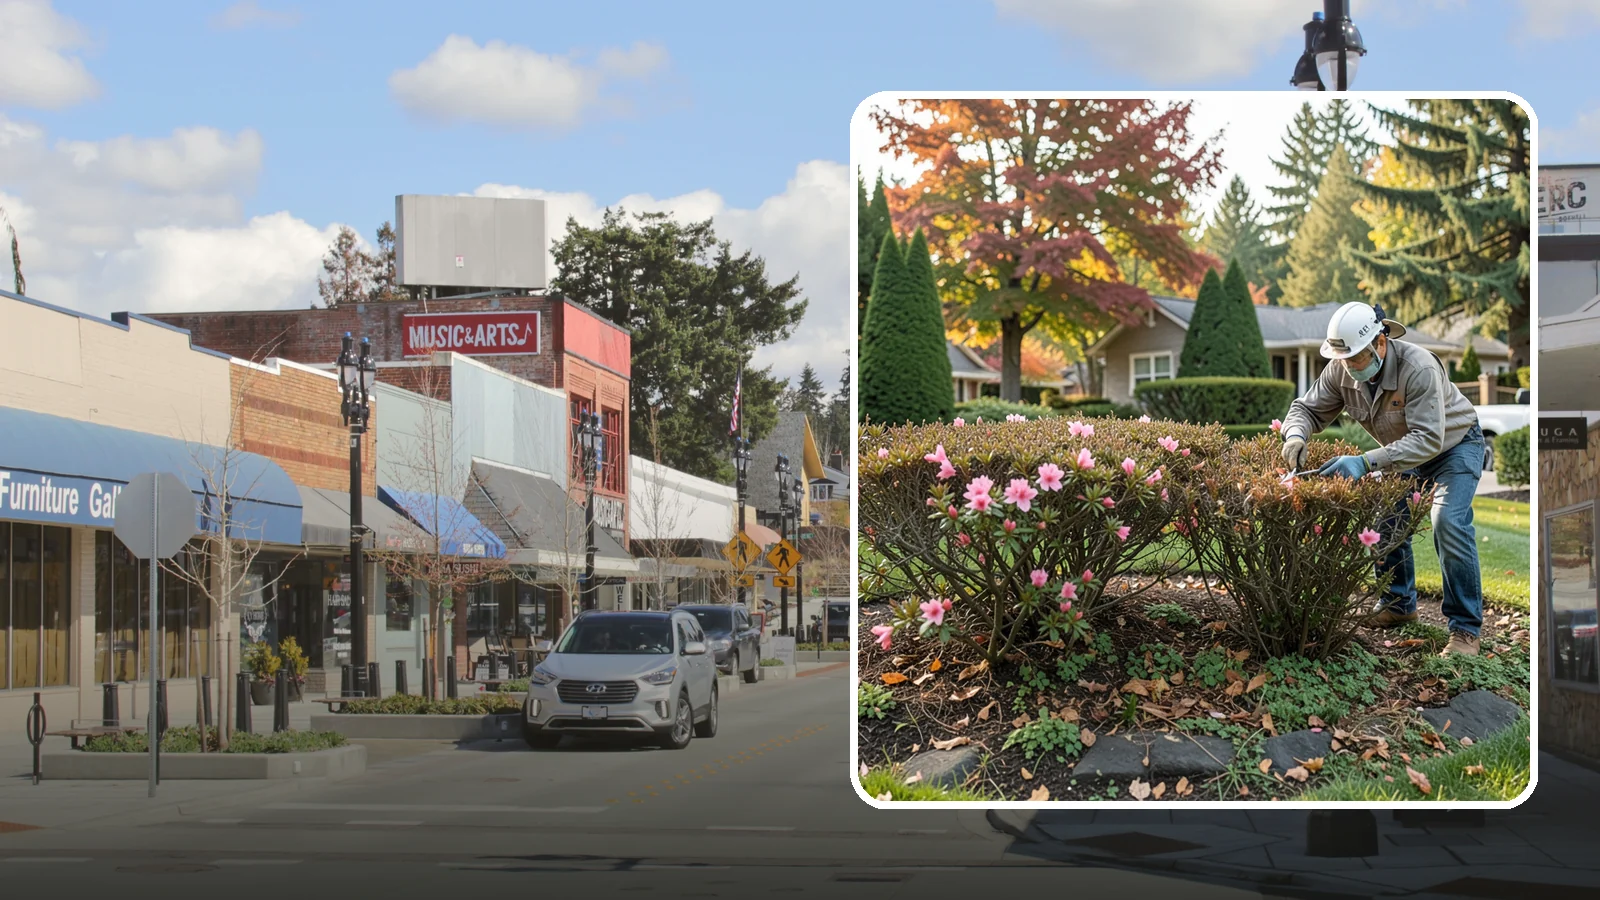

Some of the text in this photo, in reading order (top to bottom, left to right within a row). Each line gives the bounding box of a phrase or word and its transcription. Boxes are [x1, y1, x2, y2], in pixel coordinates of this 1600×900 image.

[0, 471, 122, 519] Furniture Gal
[452, 563, 479, 575] SUSHI
